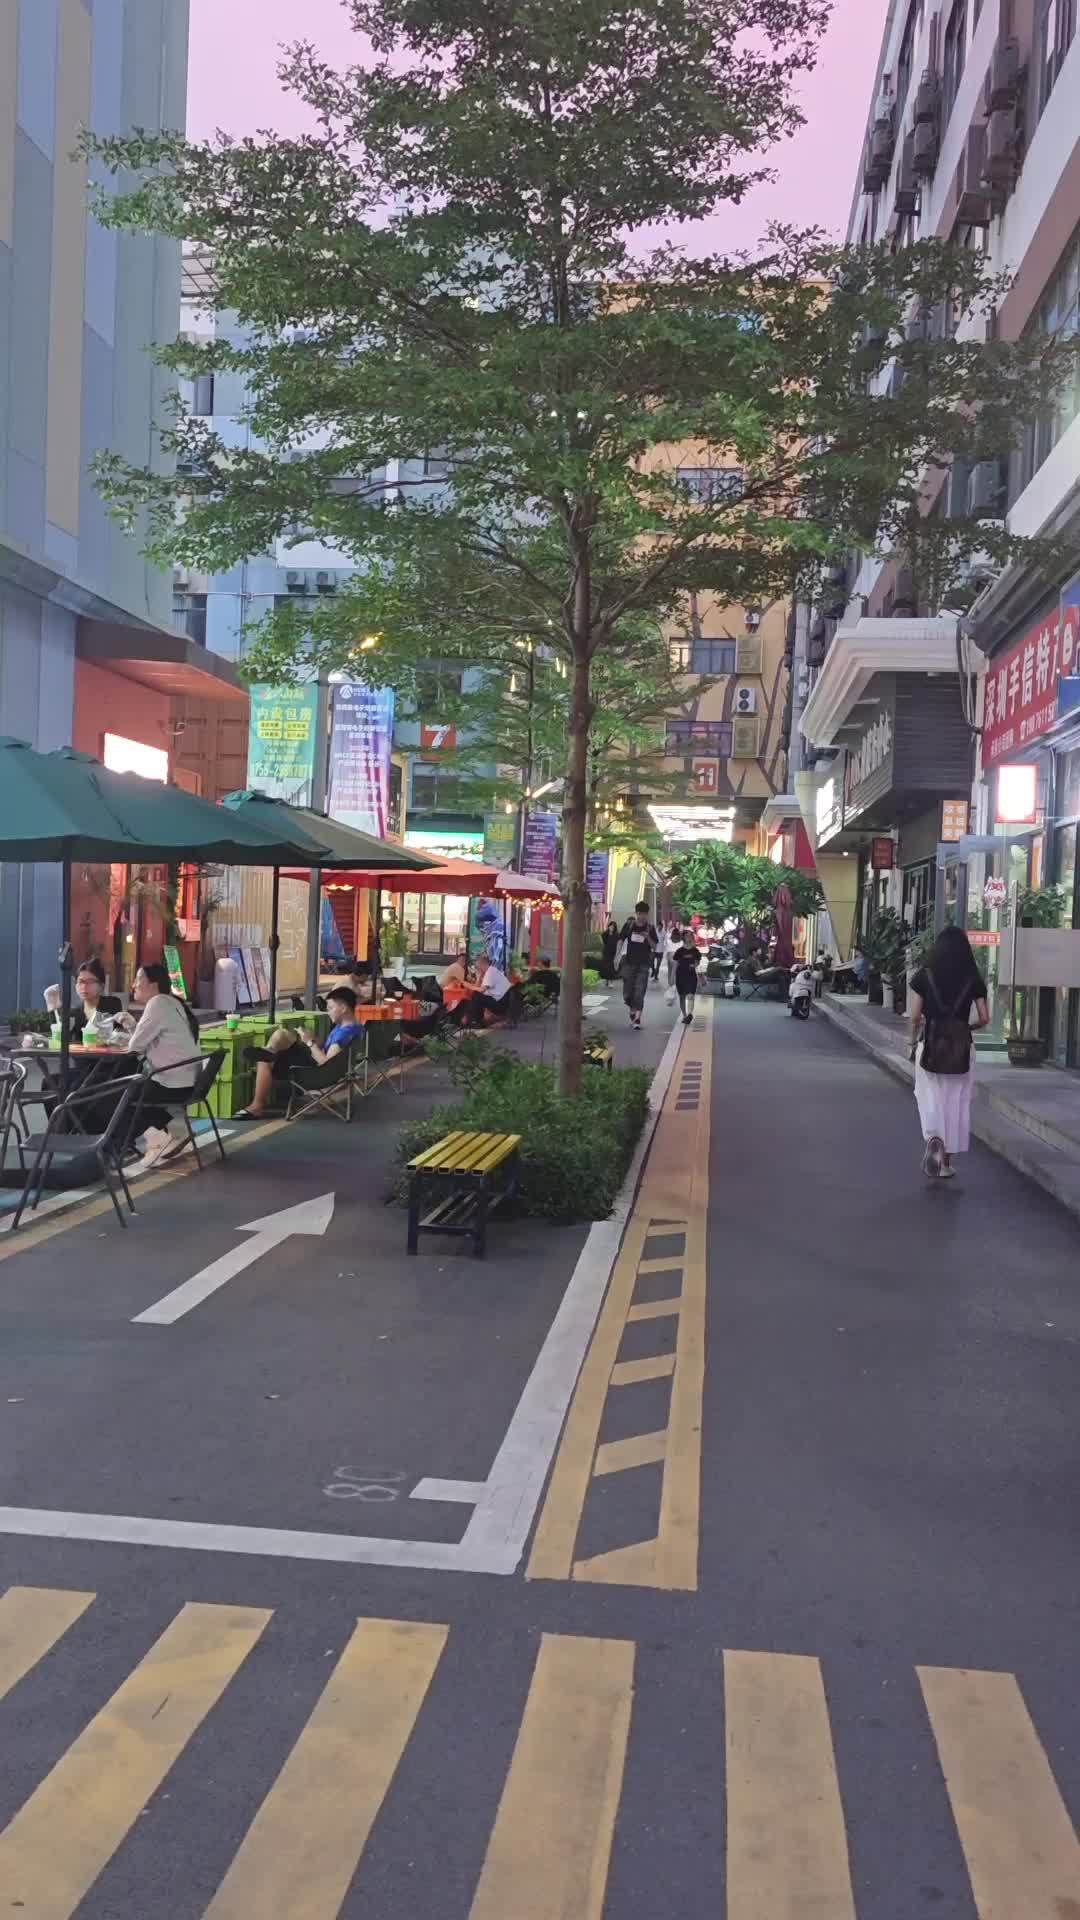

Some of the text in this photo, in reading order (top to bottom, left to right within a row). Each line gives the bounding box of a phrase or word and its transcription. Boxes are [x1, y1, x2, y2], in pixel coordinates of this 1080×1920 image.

[425, 724, 450, 749] 7
[697, 767, 714, 786] 11
[321, 1464, 407, 1502] 80
